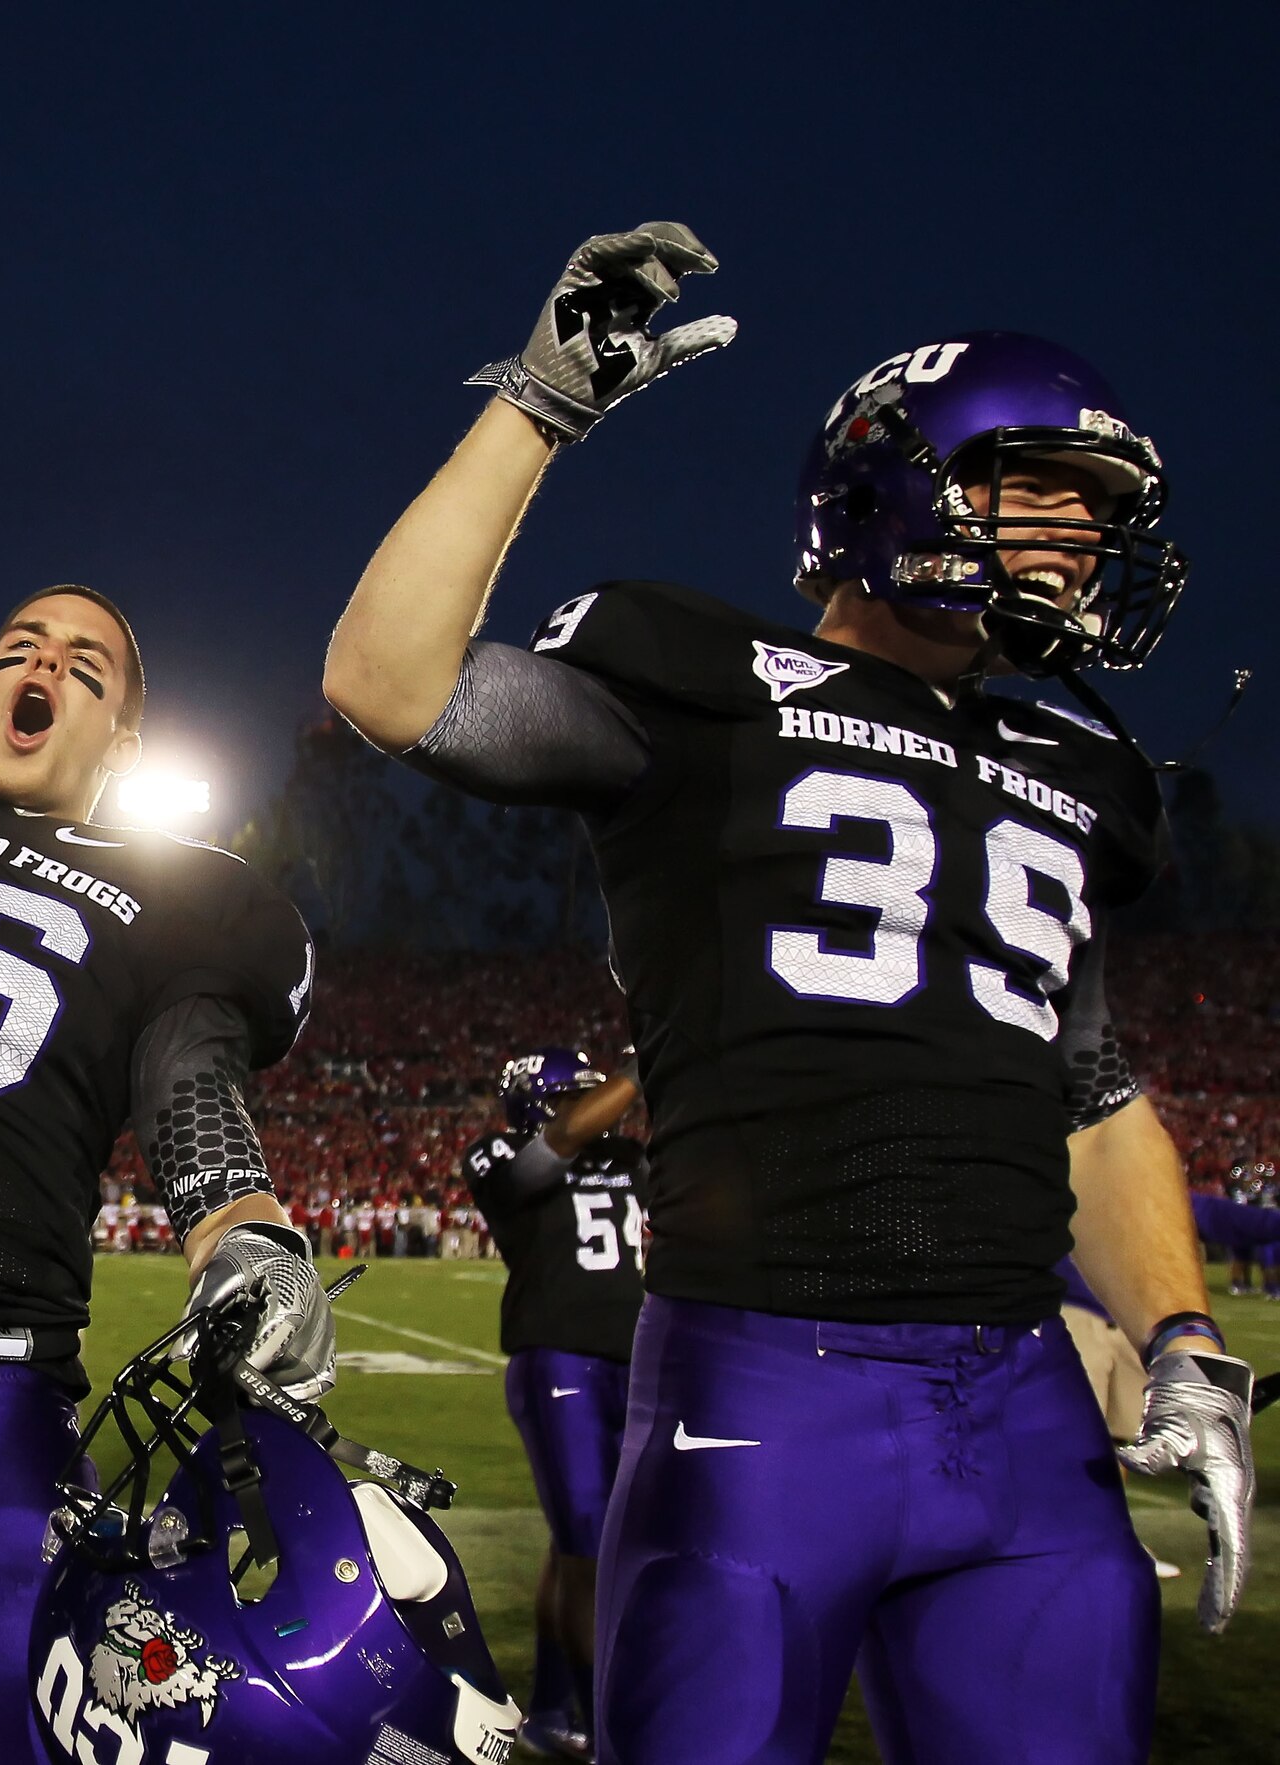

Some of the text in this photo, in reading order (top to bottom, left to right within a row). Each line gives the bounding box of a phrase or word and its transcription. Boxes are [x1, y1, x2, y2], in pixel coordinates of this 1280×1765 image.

[794, 668, 817, 677] WEST
[778, 706, 1098, 836] HORNED FROGS
[9, 845, 143, 926] FROGS
[764, 768, 1094, 1045] 39
[513, 1054, 545, 1077] CU
[469, 1137, 516, 1177] 54
[572, 1191, 644, 1272] 54
